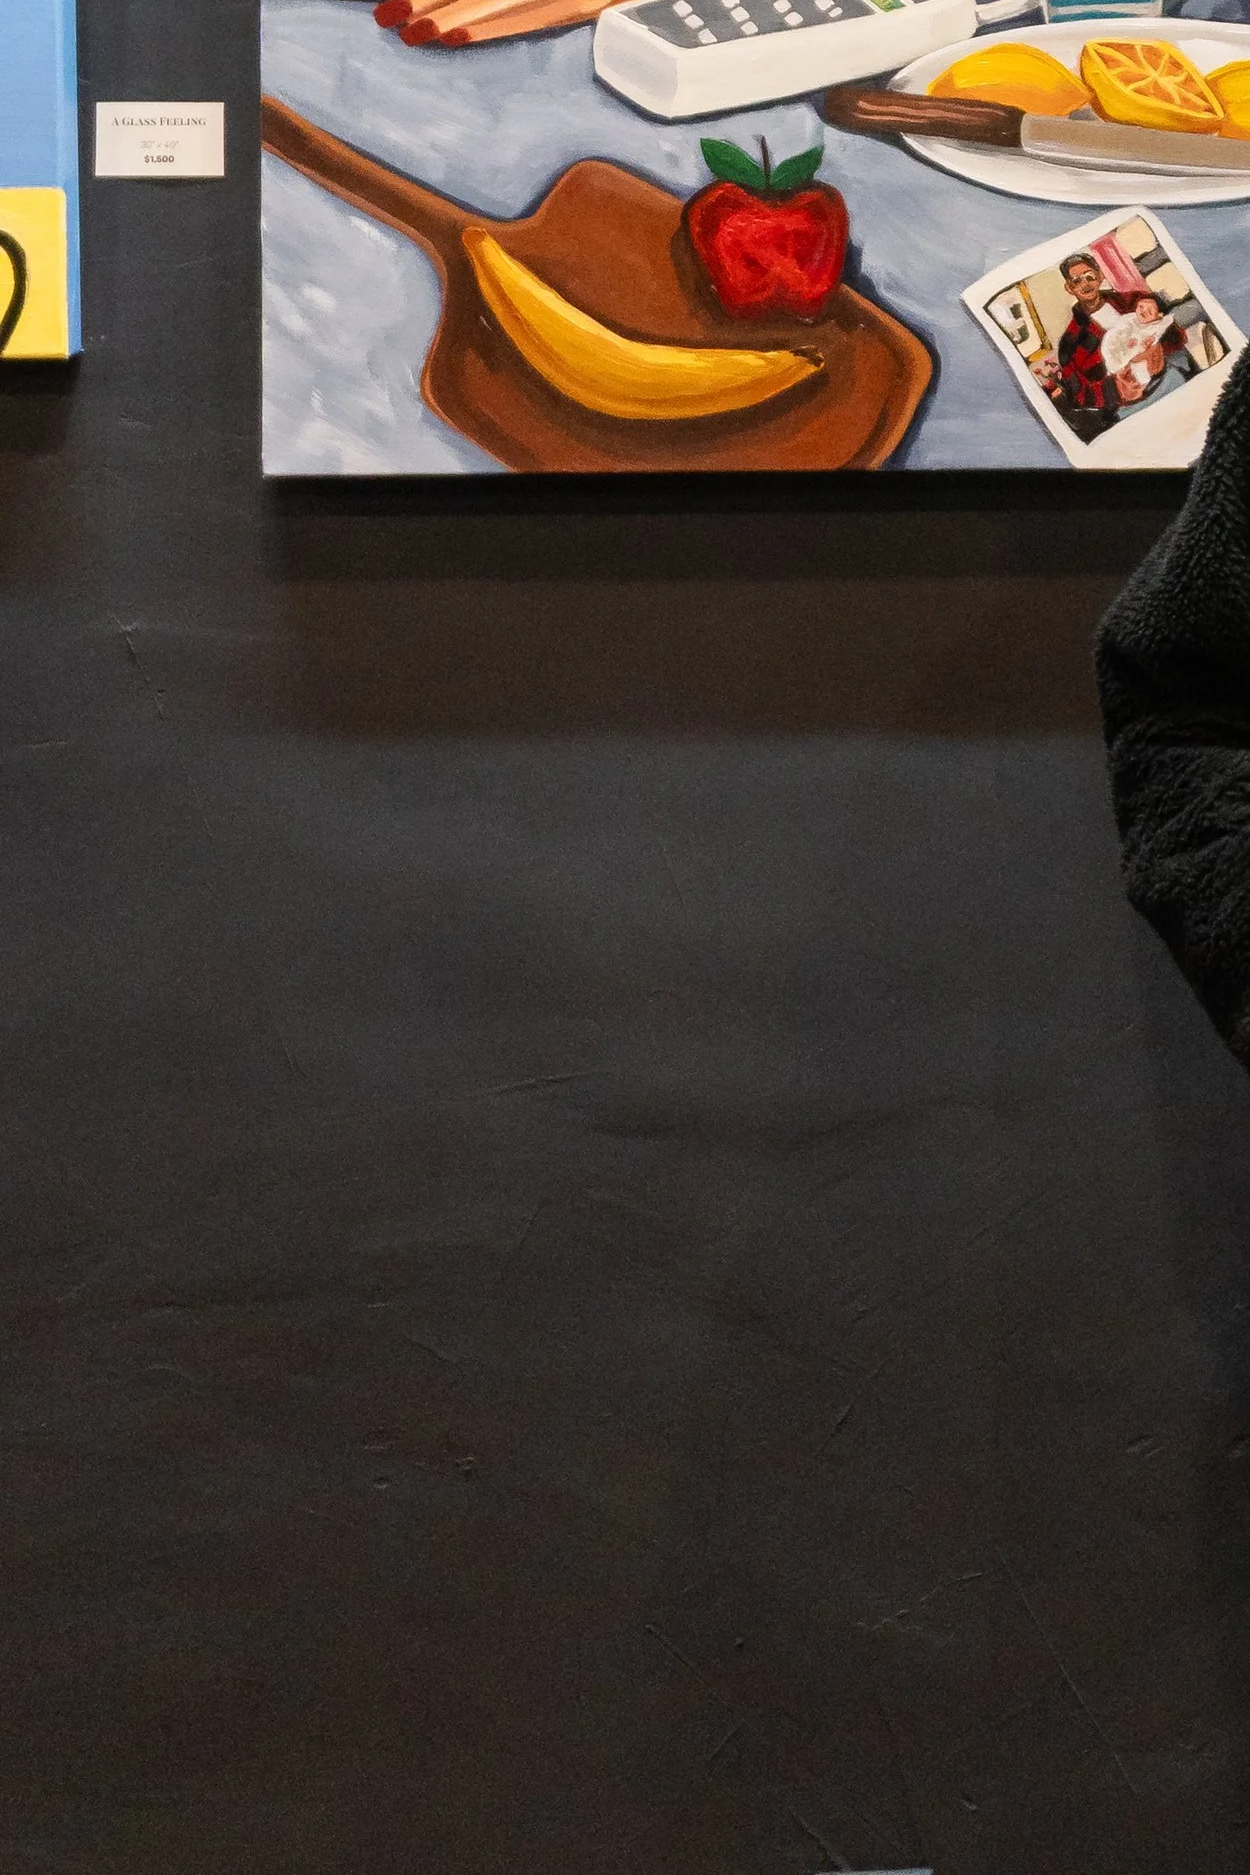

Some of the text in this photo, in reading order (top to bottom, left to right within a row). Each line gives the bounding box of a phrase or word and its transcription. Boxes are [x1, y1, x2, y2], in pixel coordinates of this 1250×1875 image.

[111, 117, 119, 125] A
[160, 116, 206, 126] FEELING
[144, 155, 175, 163] $1,500
